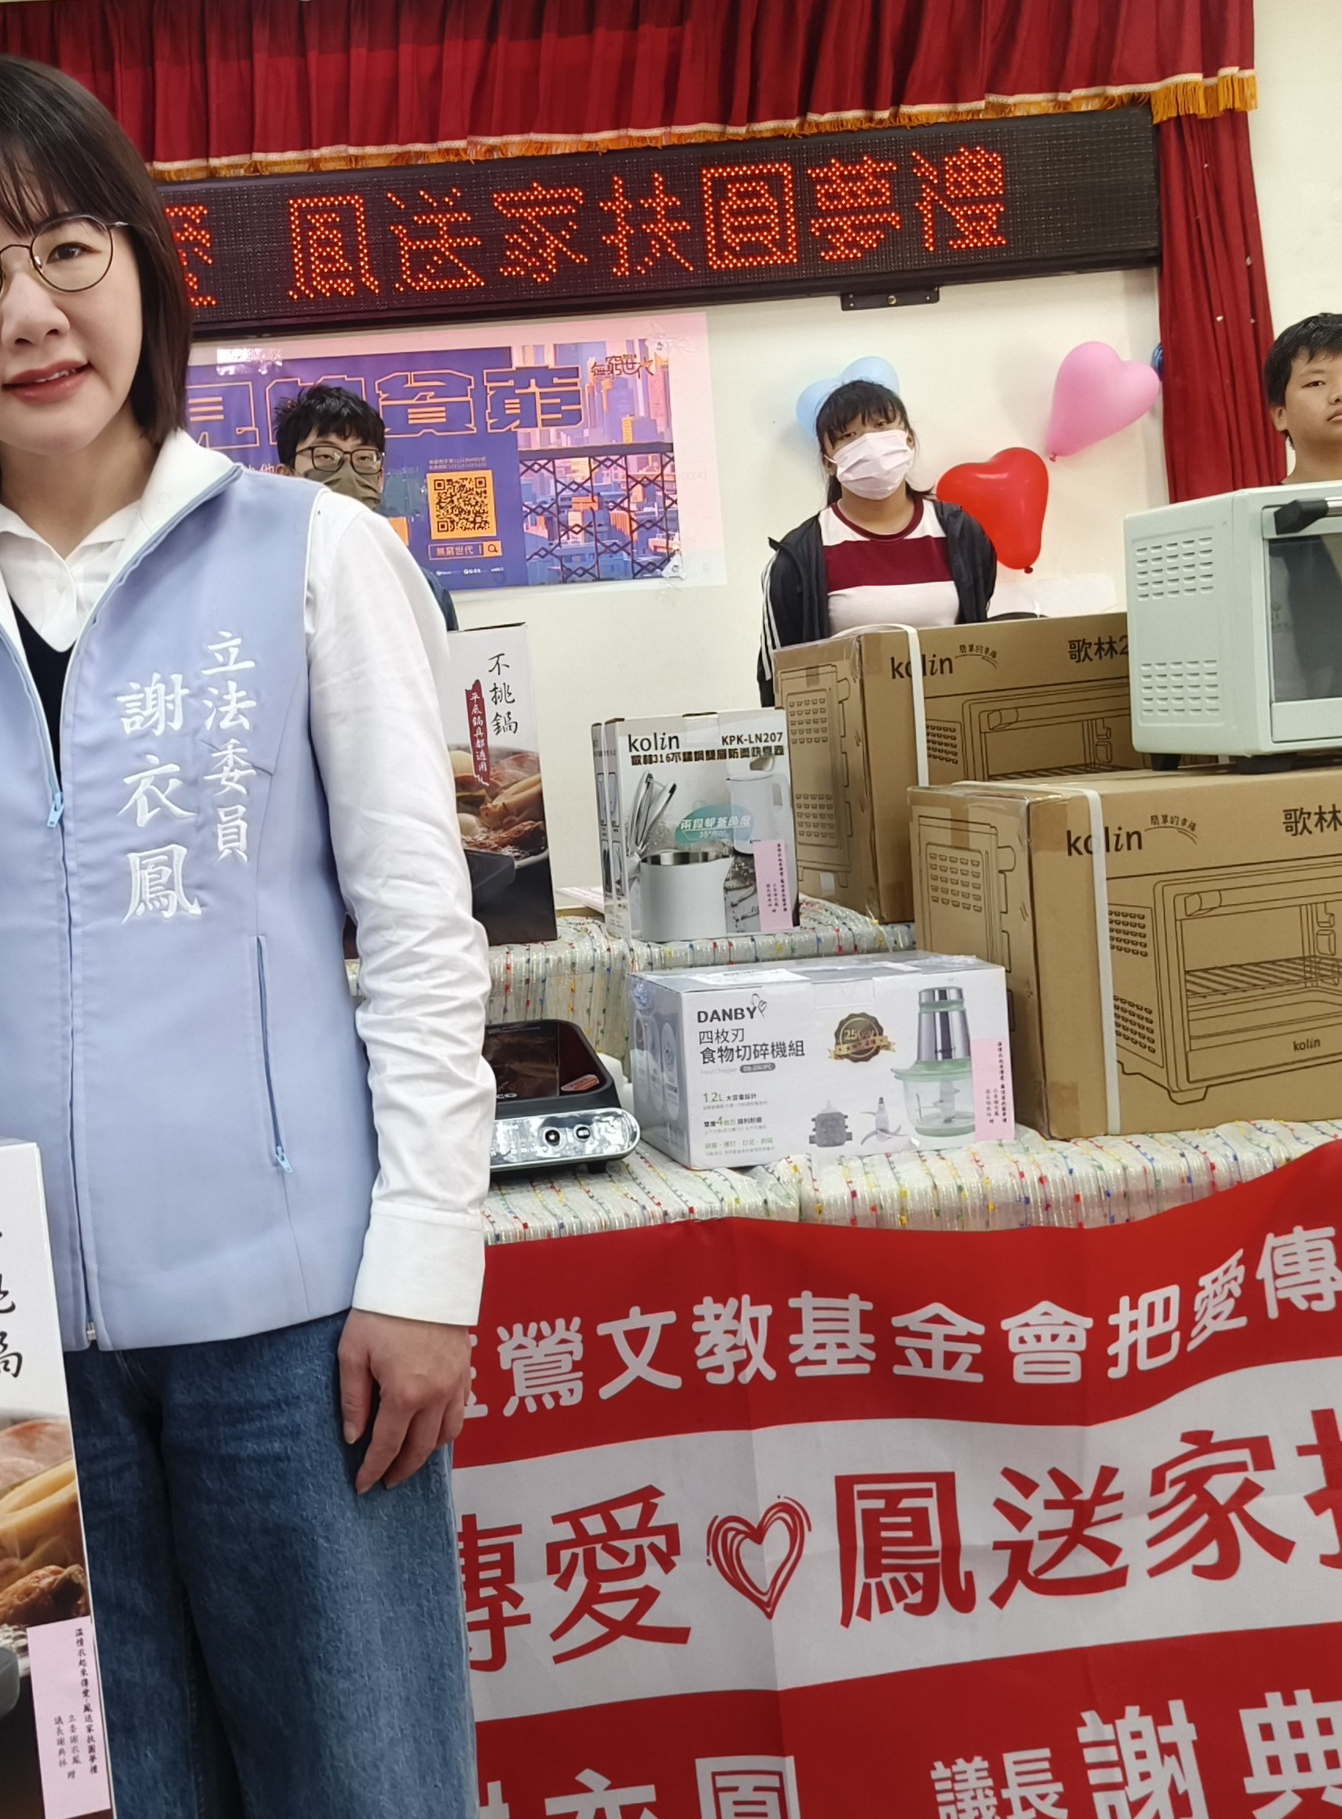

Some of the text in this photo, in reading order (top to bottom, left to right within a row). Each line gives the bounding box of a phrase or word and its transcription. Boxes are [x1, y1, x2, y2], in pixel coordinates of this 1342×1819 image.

[287, 145, 1008, 300] 鳳送家扶圓夢禮
[488, 652, 519, 736] 不挑鍋
[201, 630, 258, 864] 立法委員
[628, 732, 680, 753] kolin
[721, 732, 783, 746] KPK-LN207
[116, 671, 203, 925] 謝衣鳳
[1282, 803, 1342, 837] 歌林
[697, 1006, 757, 1023] DANBY
[699, 1028, 745, 1045] 四枚刃
[1293, 1038, 1321, 1052] kolin
[700, 1040, 805, 1064] 食物切碎機組
[931, 1748, 1068, 1819] 議長
